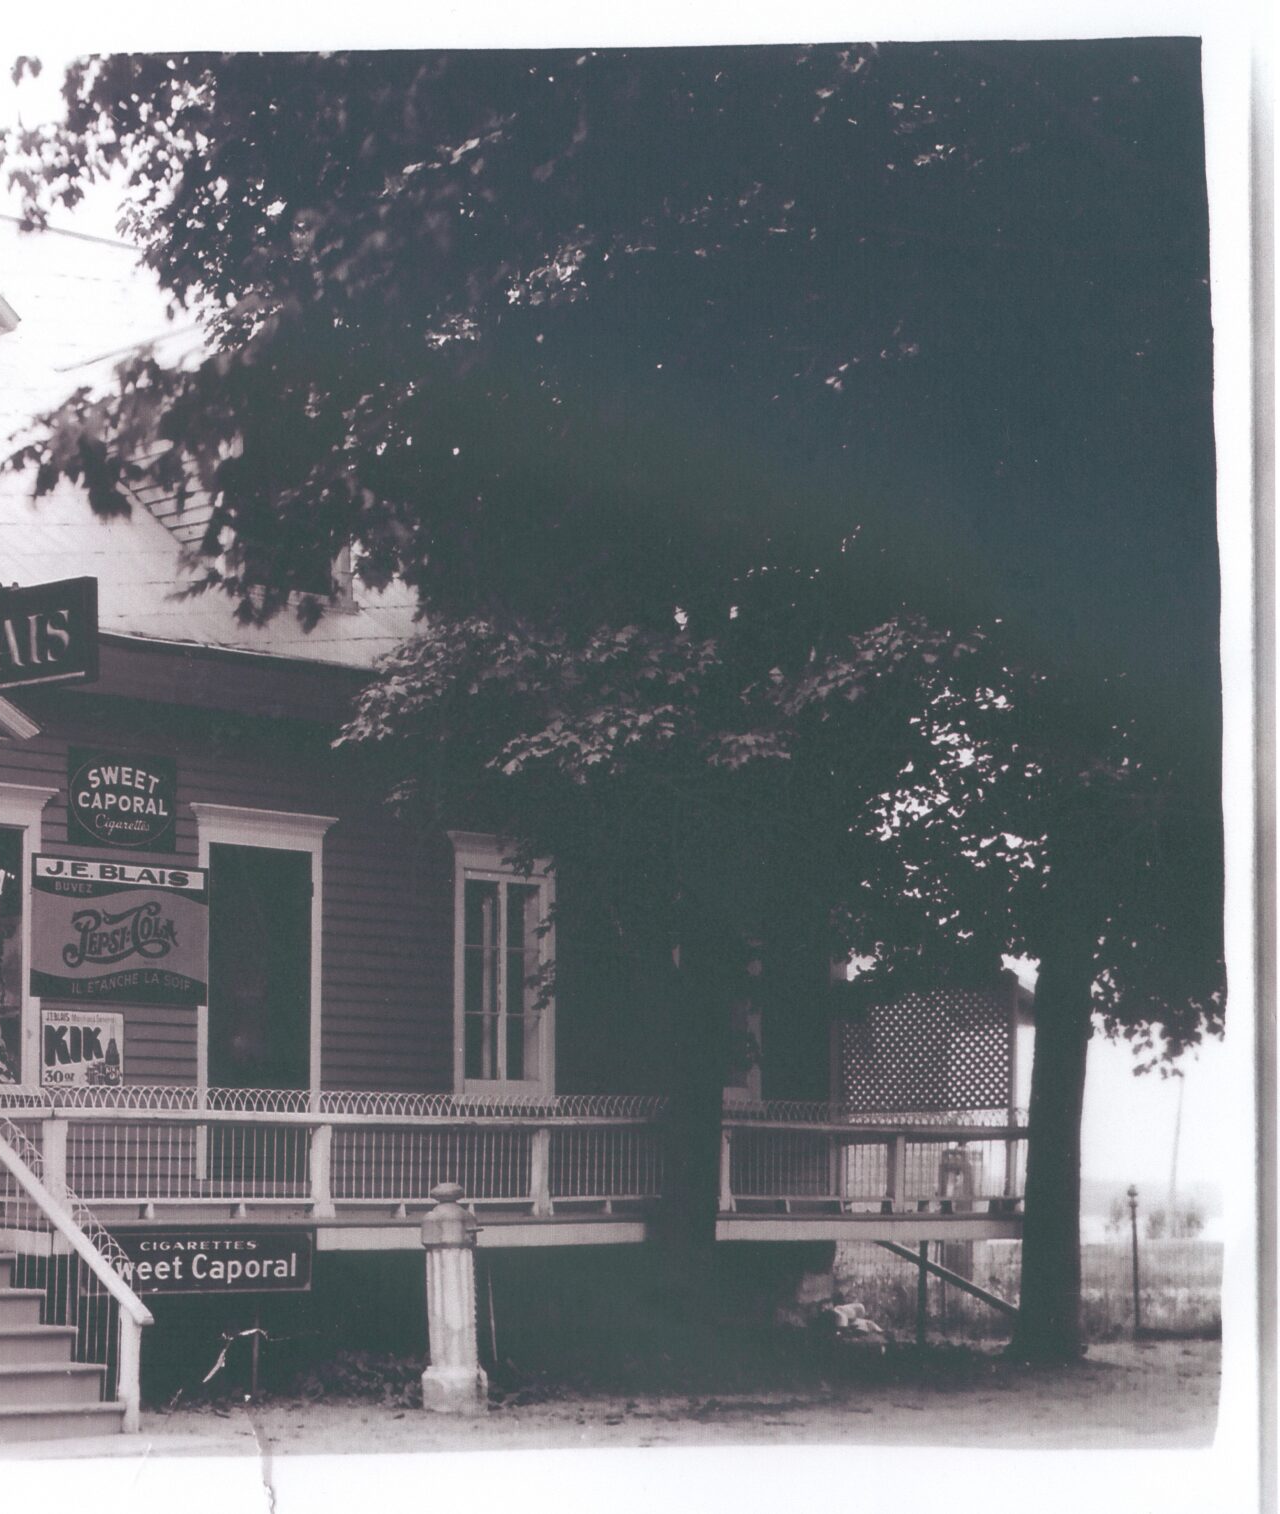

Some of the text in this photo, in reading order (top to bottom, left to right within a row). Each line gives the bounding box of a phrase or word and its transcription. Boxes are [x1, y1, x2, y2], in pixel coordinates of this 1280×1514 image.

[87, 765, 160, 795] SWEET
[77, 791, 169, 817] CAPORAL
[45, 861, 189, 887] J.E. BLAIS
[55, 880, 93, 894] BUVEZ
[144, 973, 159, 984] LA
[163, 974, 192, 992] SOIF
[44, 1024, 104, 1067] KIK
[139, 1240, 258, 1251] CIGARETTES
[104, 1252, 297, 1285] weet Caporal
